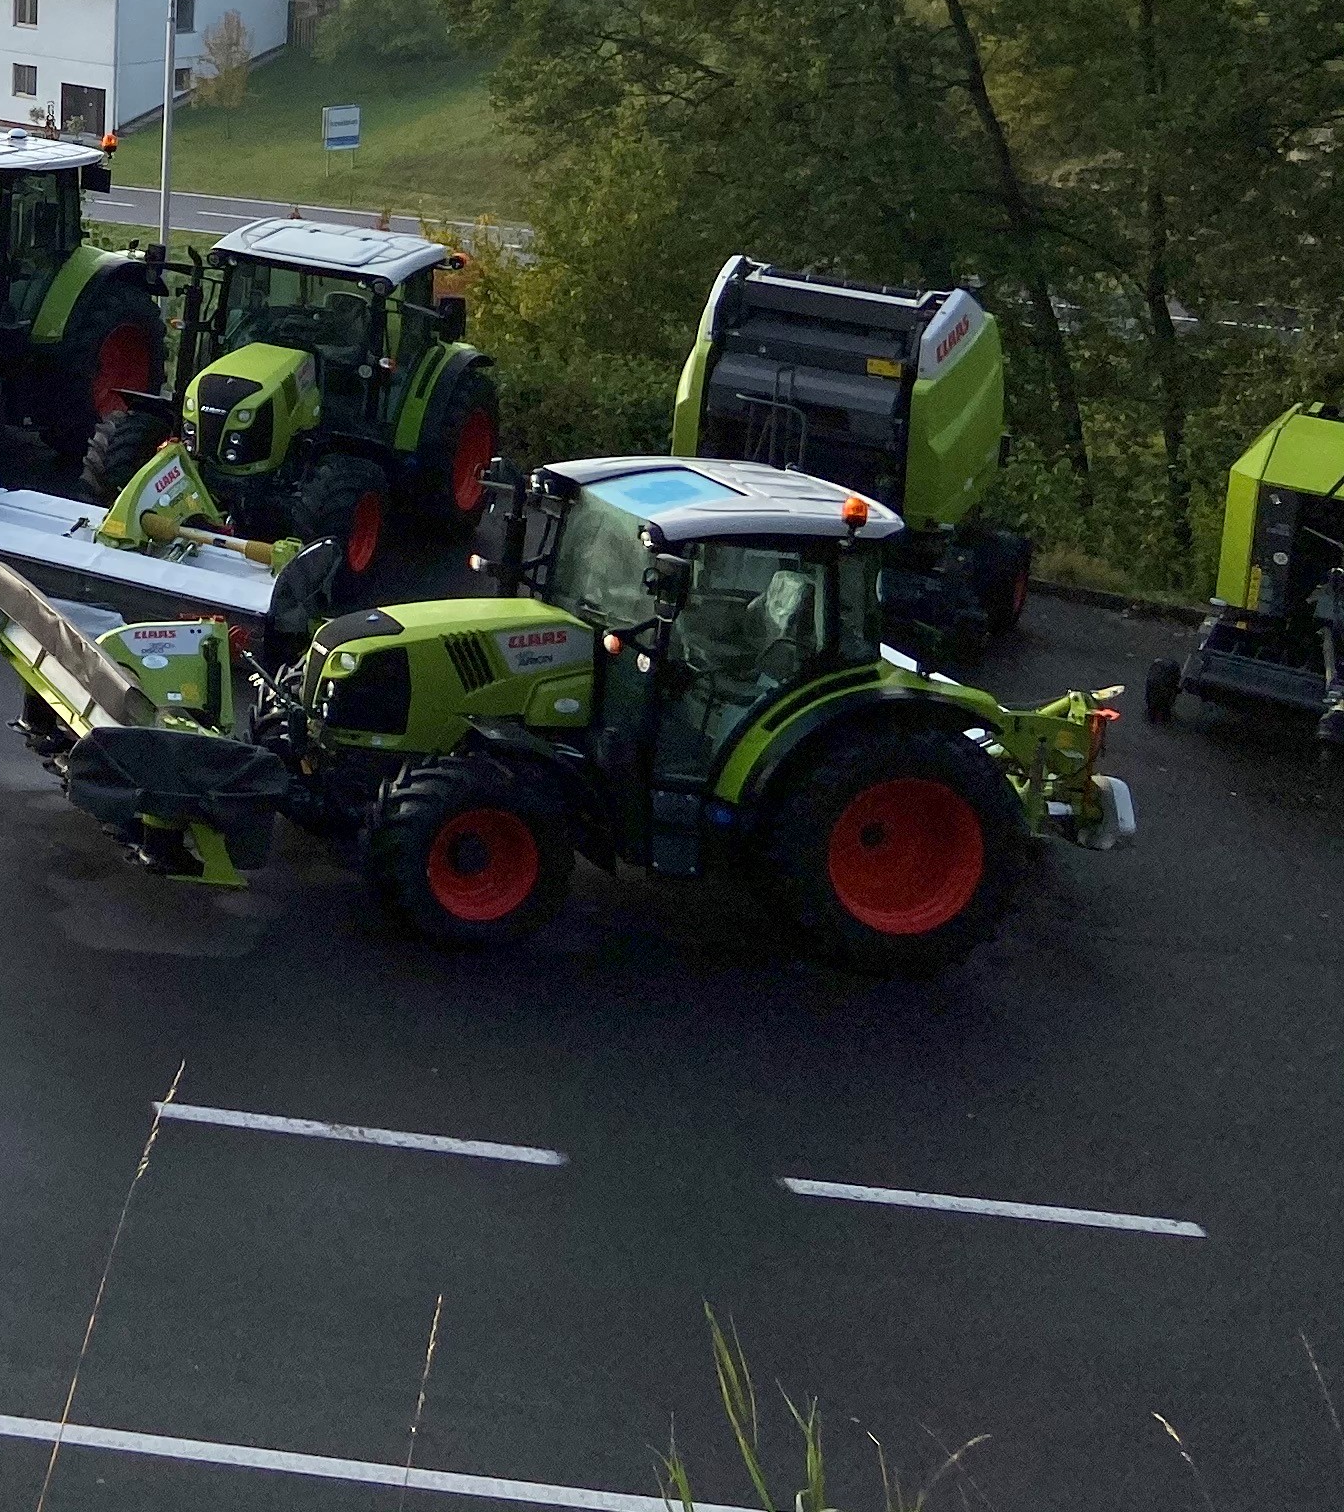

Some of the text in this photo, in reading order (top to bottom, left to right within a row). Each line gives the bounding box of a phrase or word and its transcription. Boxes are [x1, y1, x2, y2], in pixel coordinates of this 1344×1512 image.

[154, 465, 181, 493] CLAAS
[134, 629, 177, 640] CLAAS
[508, 630, 567, 648] CLAAS
